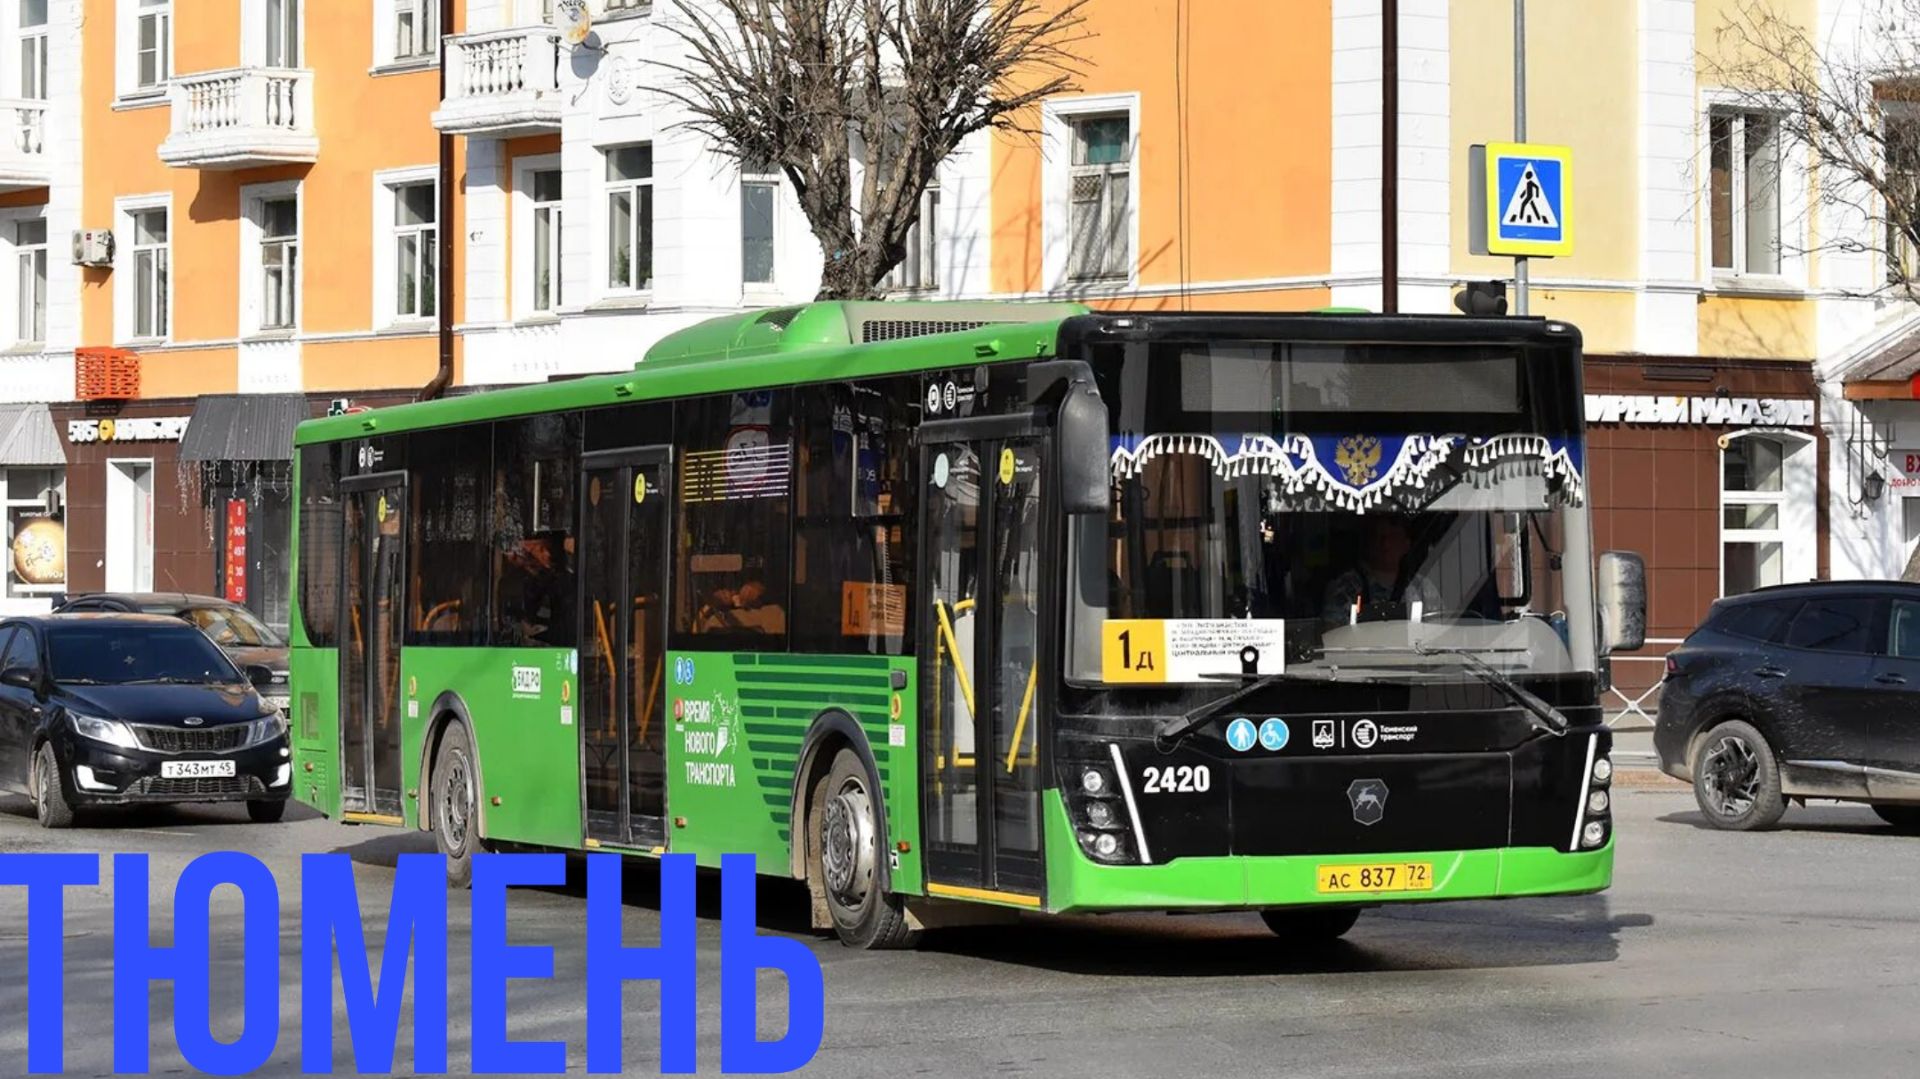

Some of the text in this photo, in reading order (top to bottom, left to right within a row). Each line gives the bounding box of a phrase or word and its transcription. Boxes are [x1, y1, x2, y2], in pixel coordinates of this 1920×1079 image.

[1691, 396, 1814, 425] МАГАЗИН
[684, 699, 711, 724] ВРЕМЯ
[684, 731, 716, 756] НОВОГО
[685, 761, 736, 787] ТРАНСПОРТА
[1143, 764, 1210, 793] 2420
[1328, 865, 1426, 889] АС 837 72
